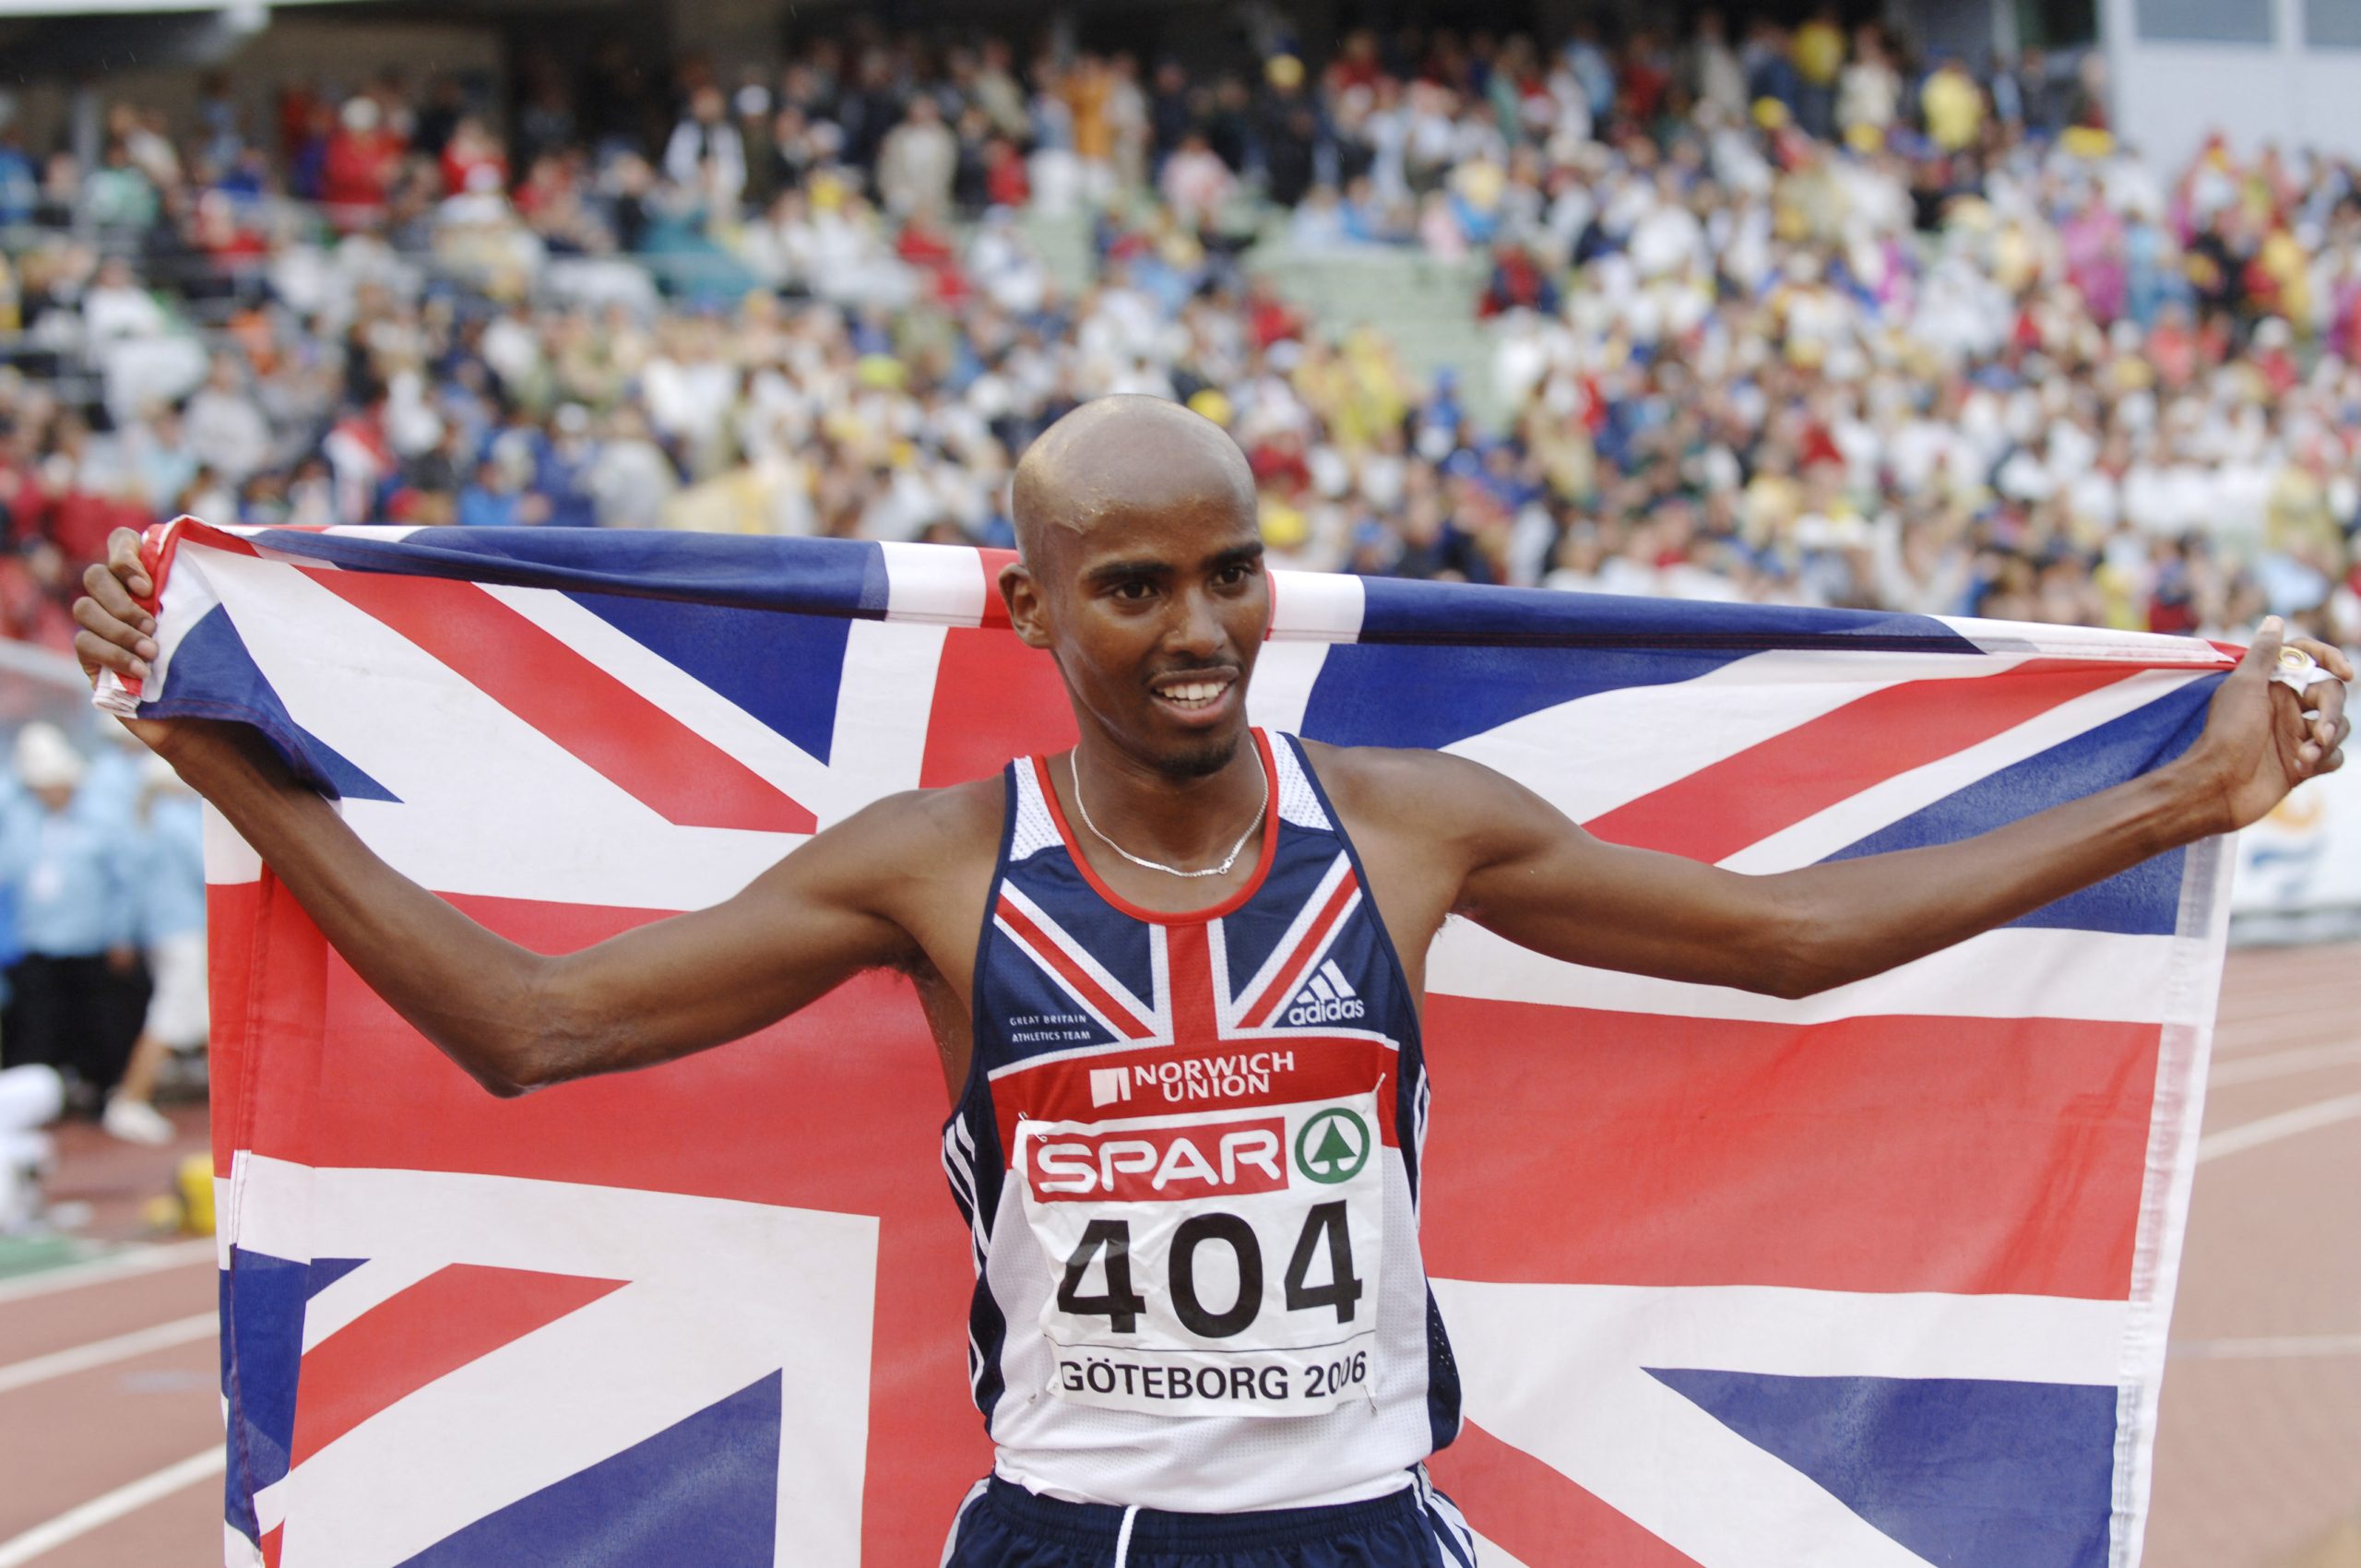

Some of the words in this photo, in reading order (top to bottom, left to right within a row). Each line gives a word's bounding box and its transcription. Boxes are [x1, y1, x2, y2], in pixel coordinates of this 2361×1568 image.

[1009, 1016, 1039, 1026] GREAT
[1043, 1014, 1086, 1024] BRITAIN
[1288, 994, 1365, 1026] adidas
[1012, 1031, 1061, 1042] ATHLETICS
[1062, 1030, 1090, 1040] TEAM
[1134, 1051, 1295, 1087] NORWICH
[1162, 1074, 1270, 1102] UNION
[1038, 1128, 1282, 1194] SPAR
[1057, 1199, 1362, 1338] 404
[1060, 1357, 1288, 1400] GÖTEBORG
[1304, 1350, 1367, 1398] 2006
